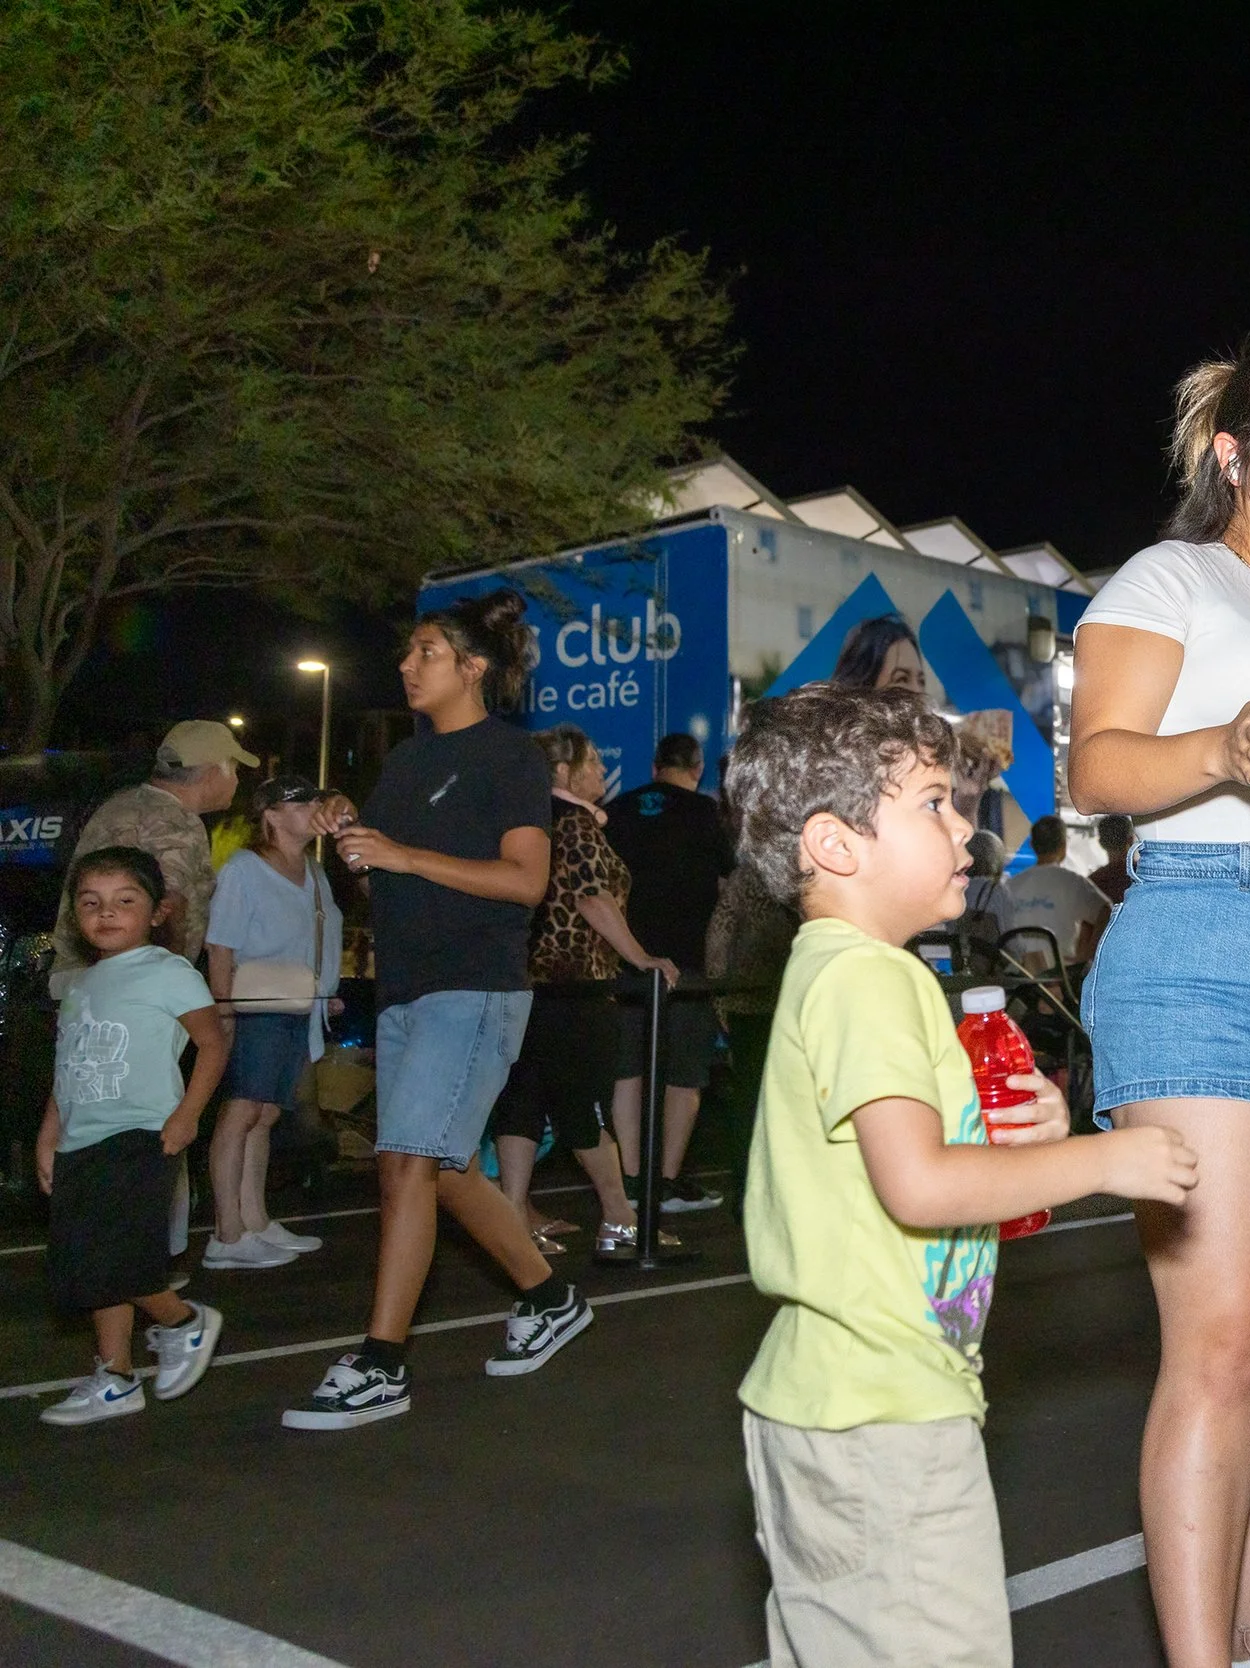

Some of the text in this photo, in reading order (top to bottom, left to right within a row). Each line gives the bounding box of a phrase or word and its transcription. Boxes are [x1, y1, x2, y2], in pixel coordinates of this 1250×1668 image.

[556, 598, 682, 668] club
[566, 669, 640, 710] café
[0, 816, 63, 842] XIS
